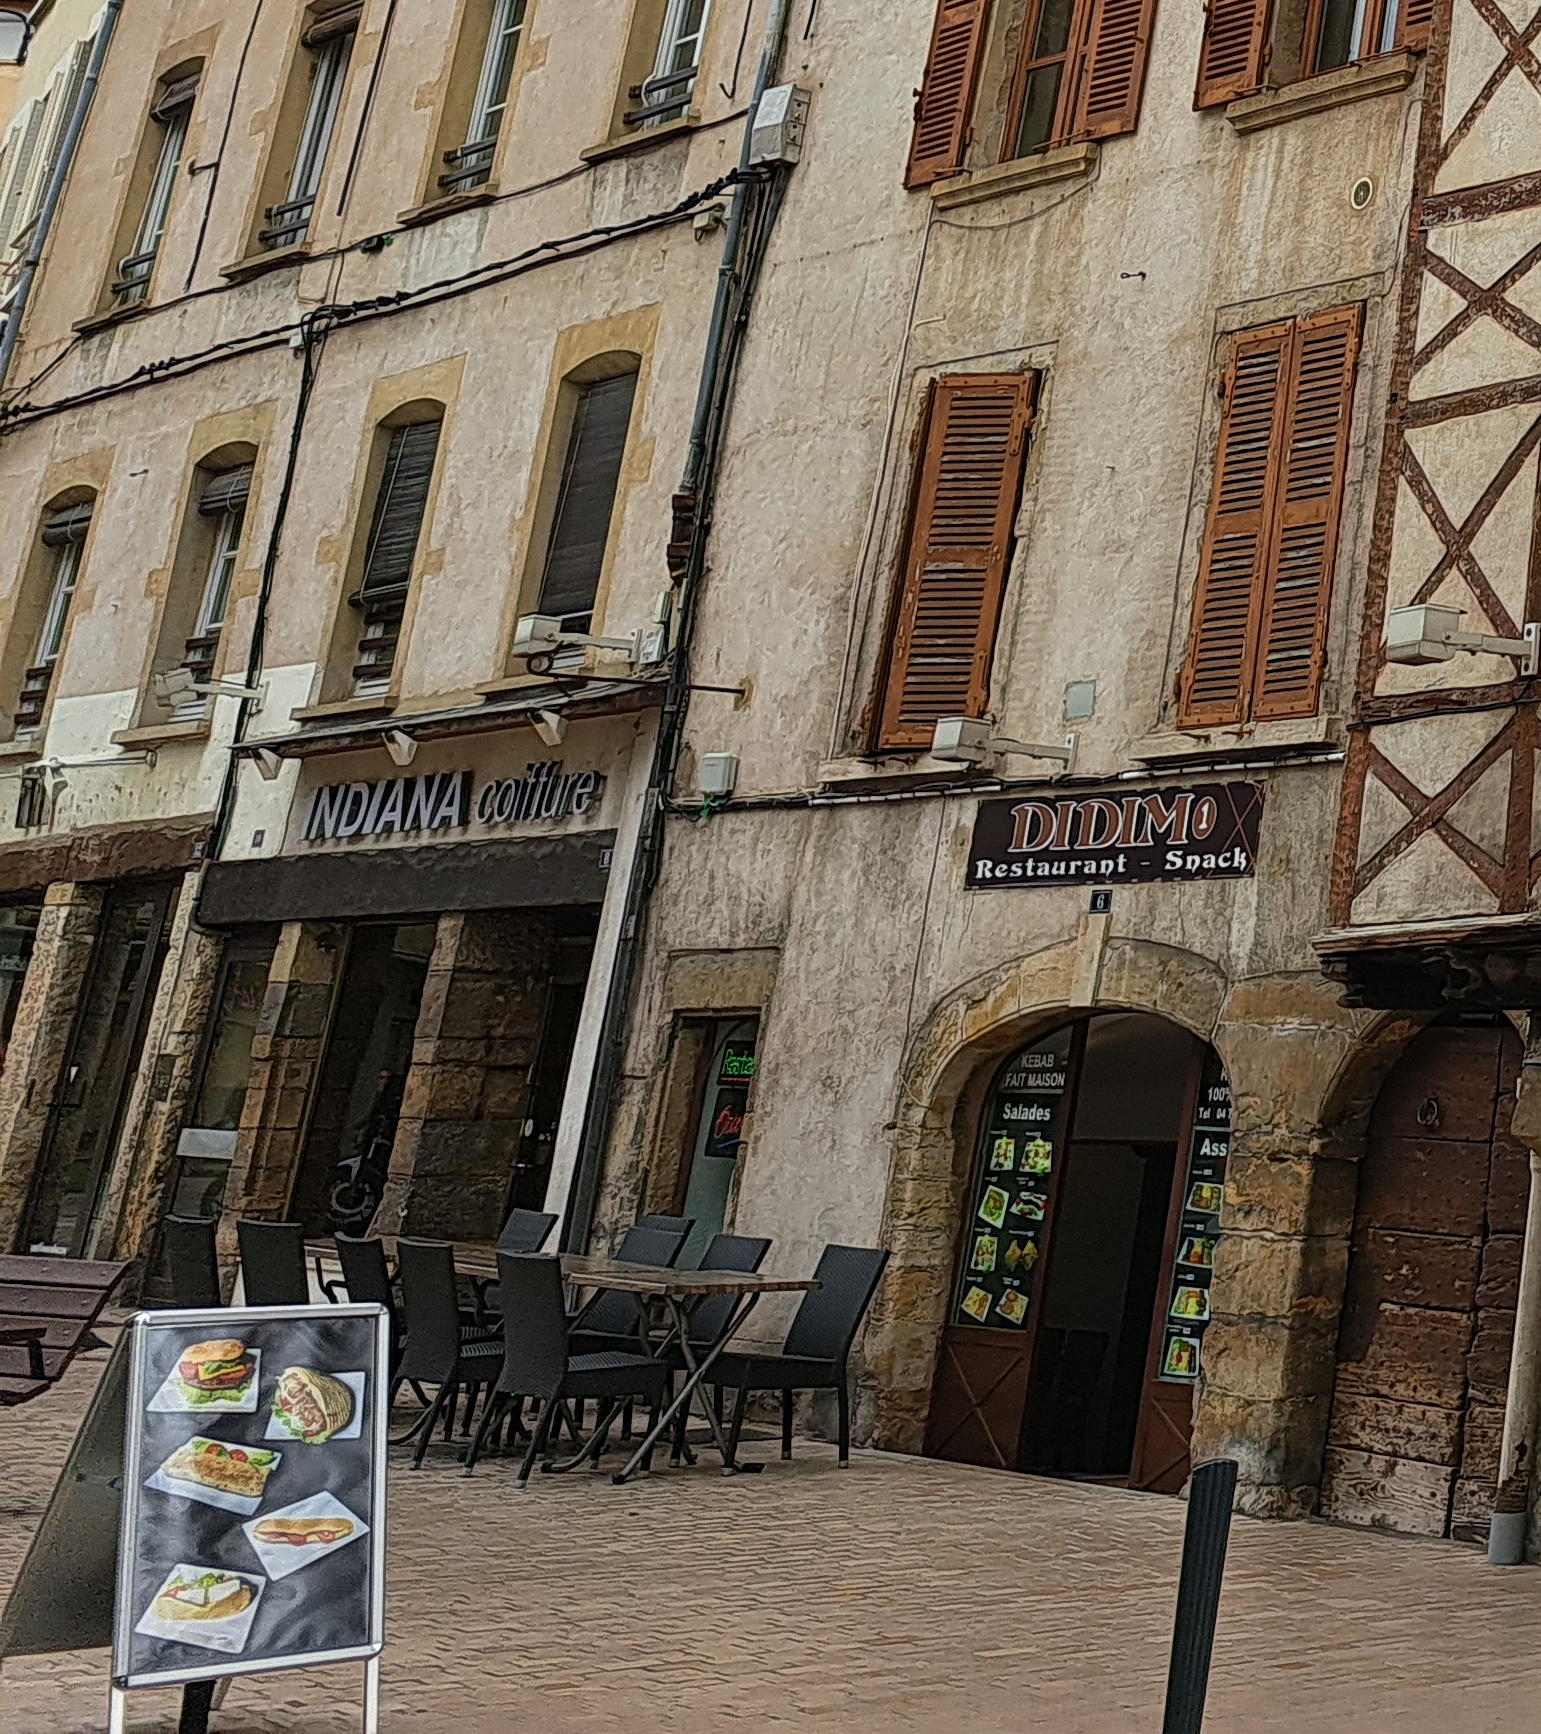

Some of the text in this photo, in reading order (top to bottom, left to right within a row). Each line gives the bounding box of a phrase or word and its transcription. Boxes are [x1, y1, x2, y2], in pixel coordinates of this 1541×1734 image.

[300, 761, 599, 841] INDIANA coiffure
[975, 853, 1127, 879] Restaurant
[1164, 847, 1247, 873] Snack
[1096, 893, 1105, 909] 6
[1020, 1053, 1055, 1068] KEBAB
[1004, 1072, 1066, 1087] FAIT MAISON
[1002, 1102, 1051, 1121] Salades
[1198, 1107, 1211, 1119] Tel
[1216, 1108, 1226, 1120] 04
[1200, 1137, 1228, 1157] Ass
